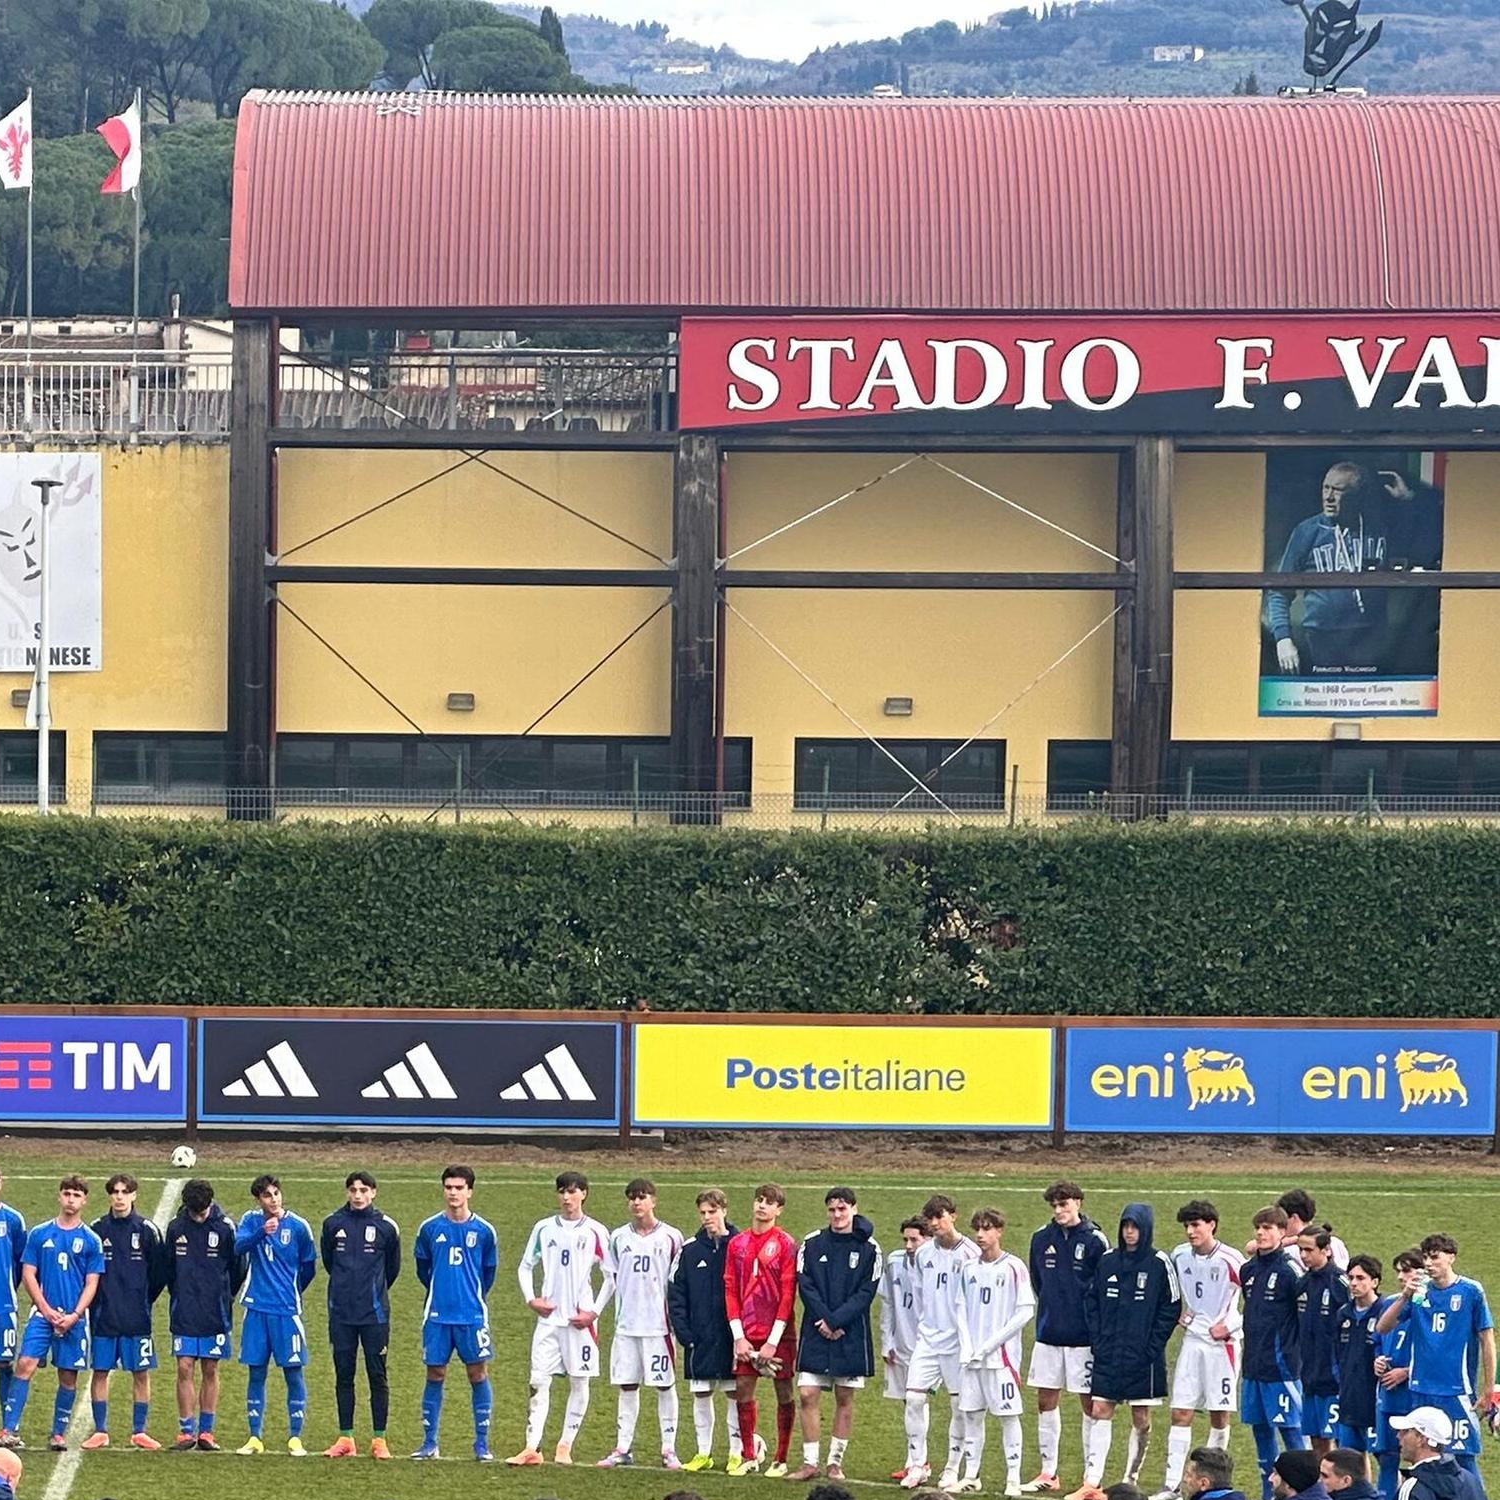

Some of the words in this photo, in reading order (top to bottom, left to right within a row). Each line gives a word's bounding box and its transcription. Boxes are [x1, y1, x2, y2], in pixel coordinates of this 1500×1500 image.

[726, 336, 1141, 412] STADIO
[1213, 337, 1302, 412] F.
[62, 1041, 172, 1091] TIM
[725, 1057, 966, 1092] Posteitaliane
[1090, 1052, 1175, 1098] eni
[1301, 1053, 1386, 1100] eni
[57, 1252, 68, 1271] 9
[448, 1246, 463, 1265] 15
[561, 1249, 570, 1267] 8
[633, 1255, 650, 1273] 20
[979, 1286, 992, 1305] 10
[1195, 1281, 1203, 1299] 6
[1431, 1312, 1446, 1333] 16
[3, 1328, 16, 1347] 10
[292, 1334, 301, 1353] 11
[477, 1328, 490, 1349] 15
[1395, 1330, 1406, 1350] 7
[140, 1338, 153, 1358] 21
[582, 1345, 591, 1363] 8
[651, 1354, 668, 1373] 20
[1001, 1382, 1015, 1401] 10
[1221, 1377, 1231, 1395] 6
[1278, 1393, 1290, 1413] 4
[1328, 1404, 1340, 1424] 5
[1454, 1418, 1469, 1440] 16
